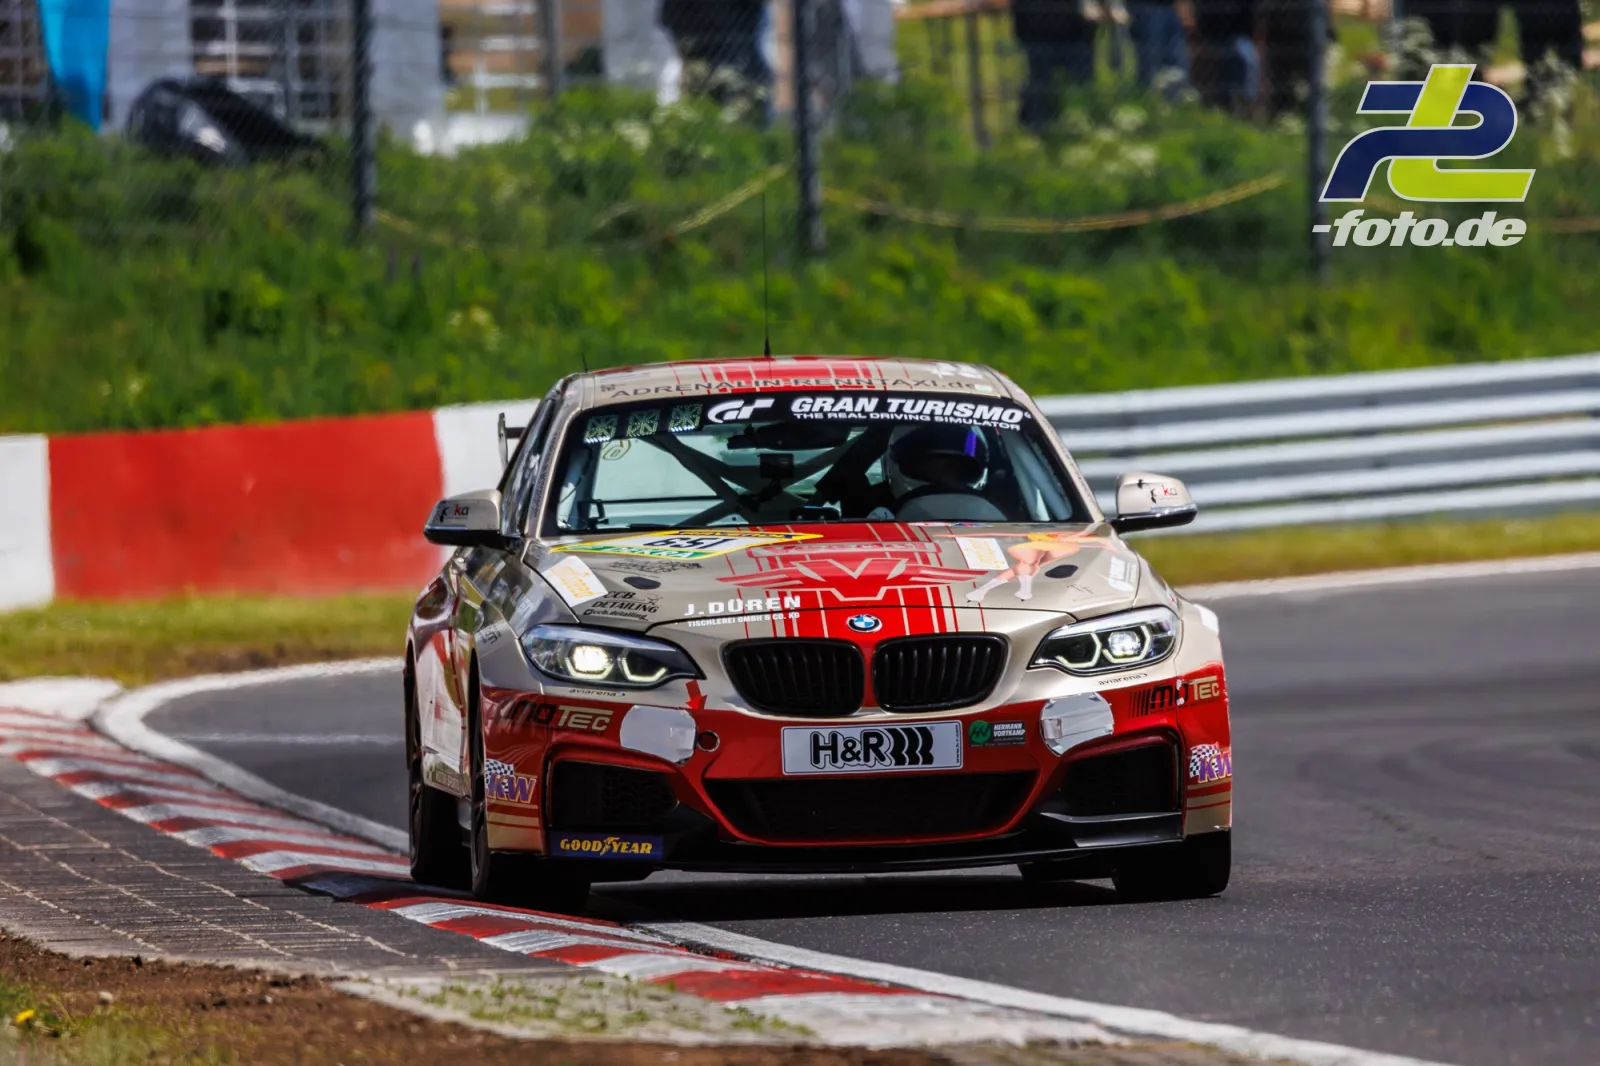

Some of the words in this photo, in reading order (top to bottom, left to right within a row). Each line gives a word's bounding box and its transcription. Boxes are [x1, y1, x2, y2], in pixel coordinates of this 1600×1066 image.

[790, 396, 879, 414] GRAN
[887, 397, 1024, 424] TURISMO
[793, 412, 823, 420] THE
[828, 412, 867, 420] REAL
[870, 412, 931, 422] DRIVING
[934, 415, 1021, 432] SIMULATOR
[592, 601, 660, 613] DETAILING
[687, 618, 735, 627] TISCHLEREI
[789, 611, 800, 619] KG
[993, 729, 1026, 737] VORTKAMP
[810, 729, 892, 769] H&R
[1198, 751, 1232, 783] KW
[486, 772, 537, 804] KW
[560, 837, 652, 856] GOODYEAR
